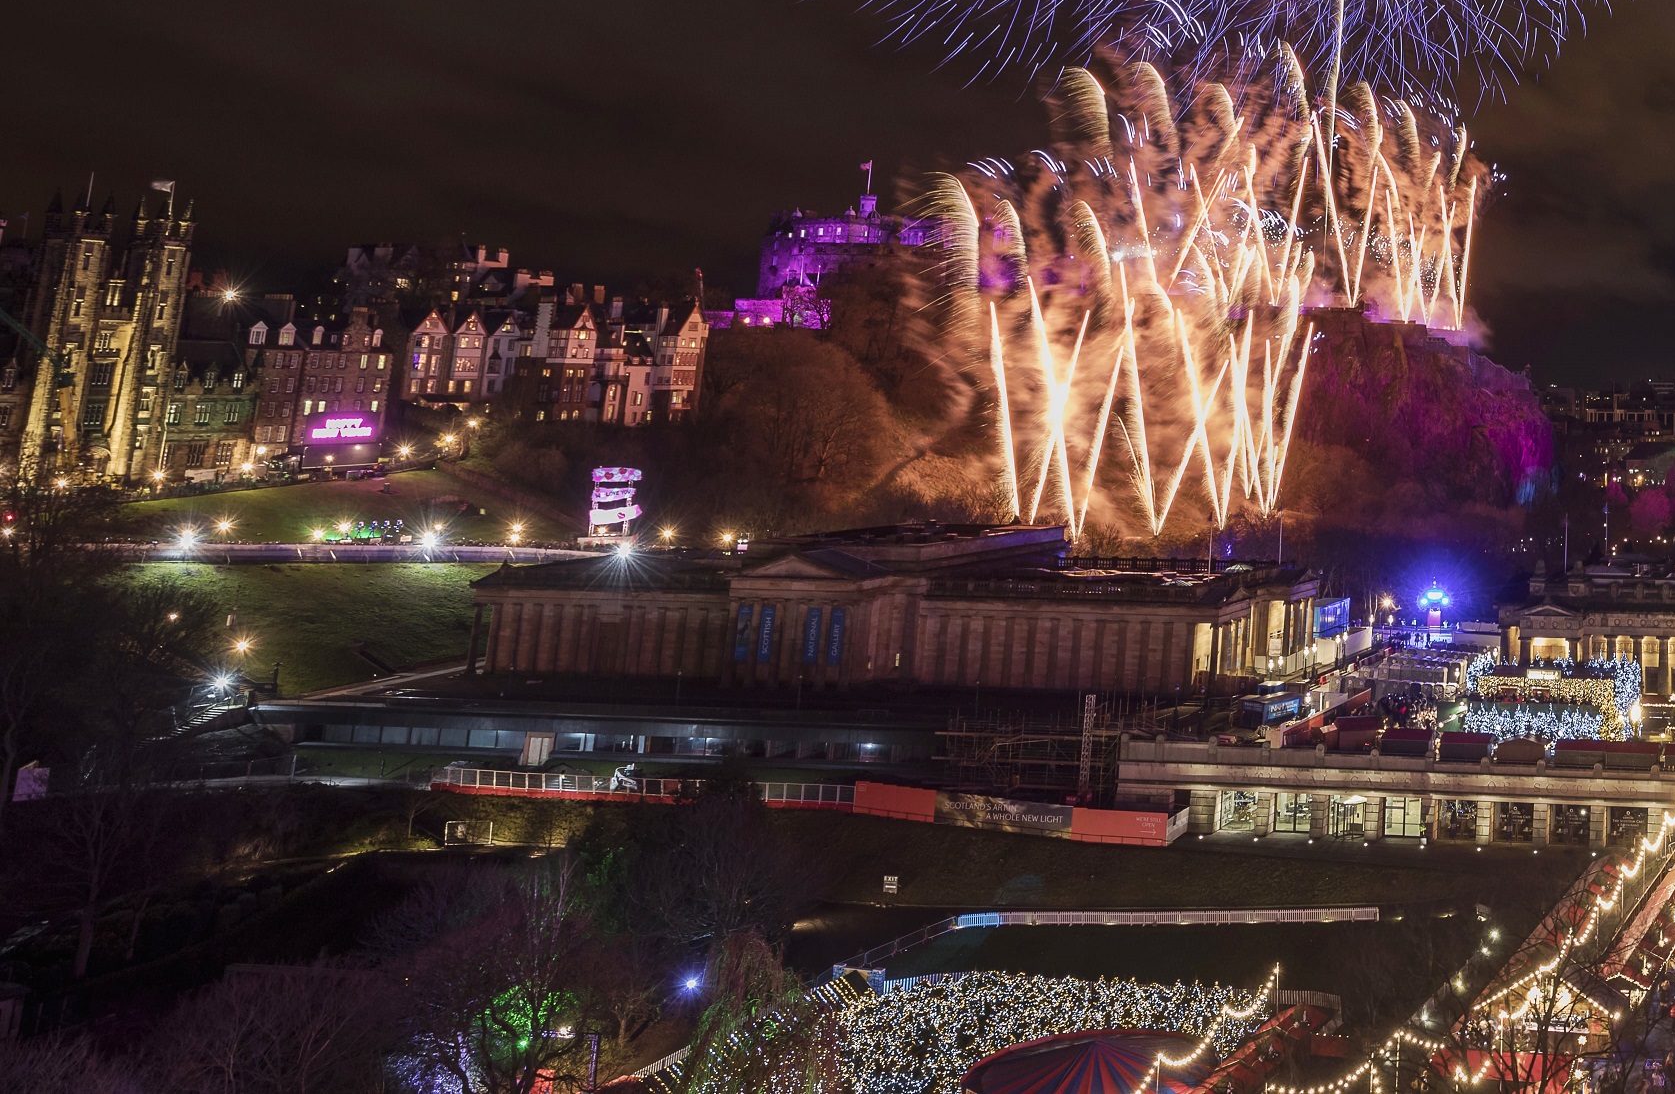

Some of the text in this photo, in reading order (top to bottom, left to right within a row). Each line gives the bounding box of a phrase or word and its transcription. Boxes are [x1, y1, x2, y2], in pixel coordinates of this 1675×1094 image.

[762, 617, 772, 654] SCOTTISH
[808, 617, 818, 657] NATIONAL
[831, 624, 840, 656] GALLERY
[1229, 771, 1329, 785] NATIONAL
[1350, 775, 1465, 791] GALLERIES
[1533, 782, 1639, 798] SCOTLAND
[945, 801, 992, 812] SCOTLAND'S
[993, 813, 1020, 821] WHOLE
[1022, 814, 1039, 822] NEW
[1040, 815, 1064, 823] LIGHT
